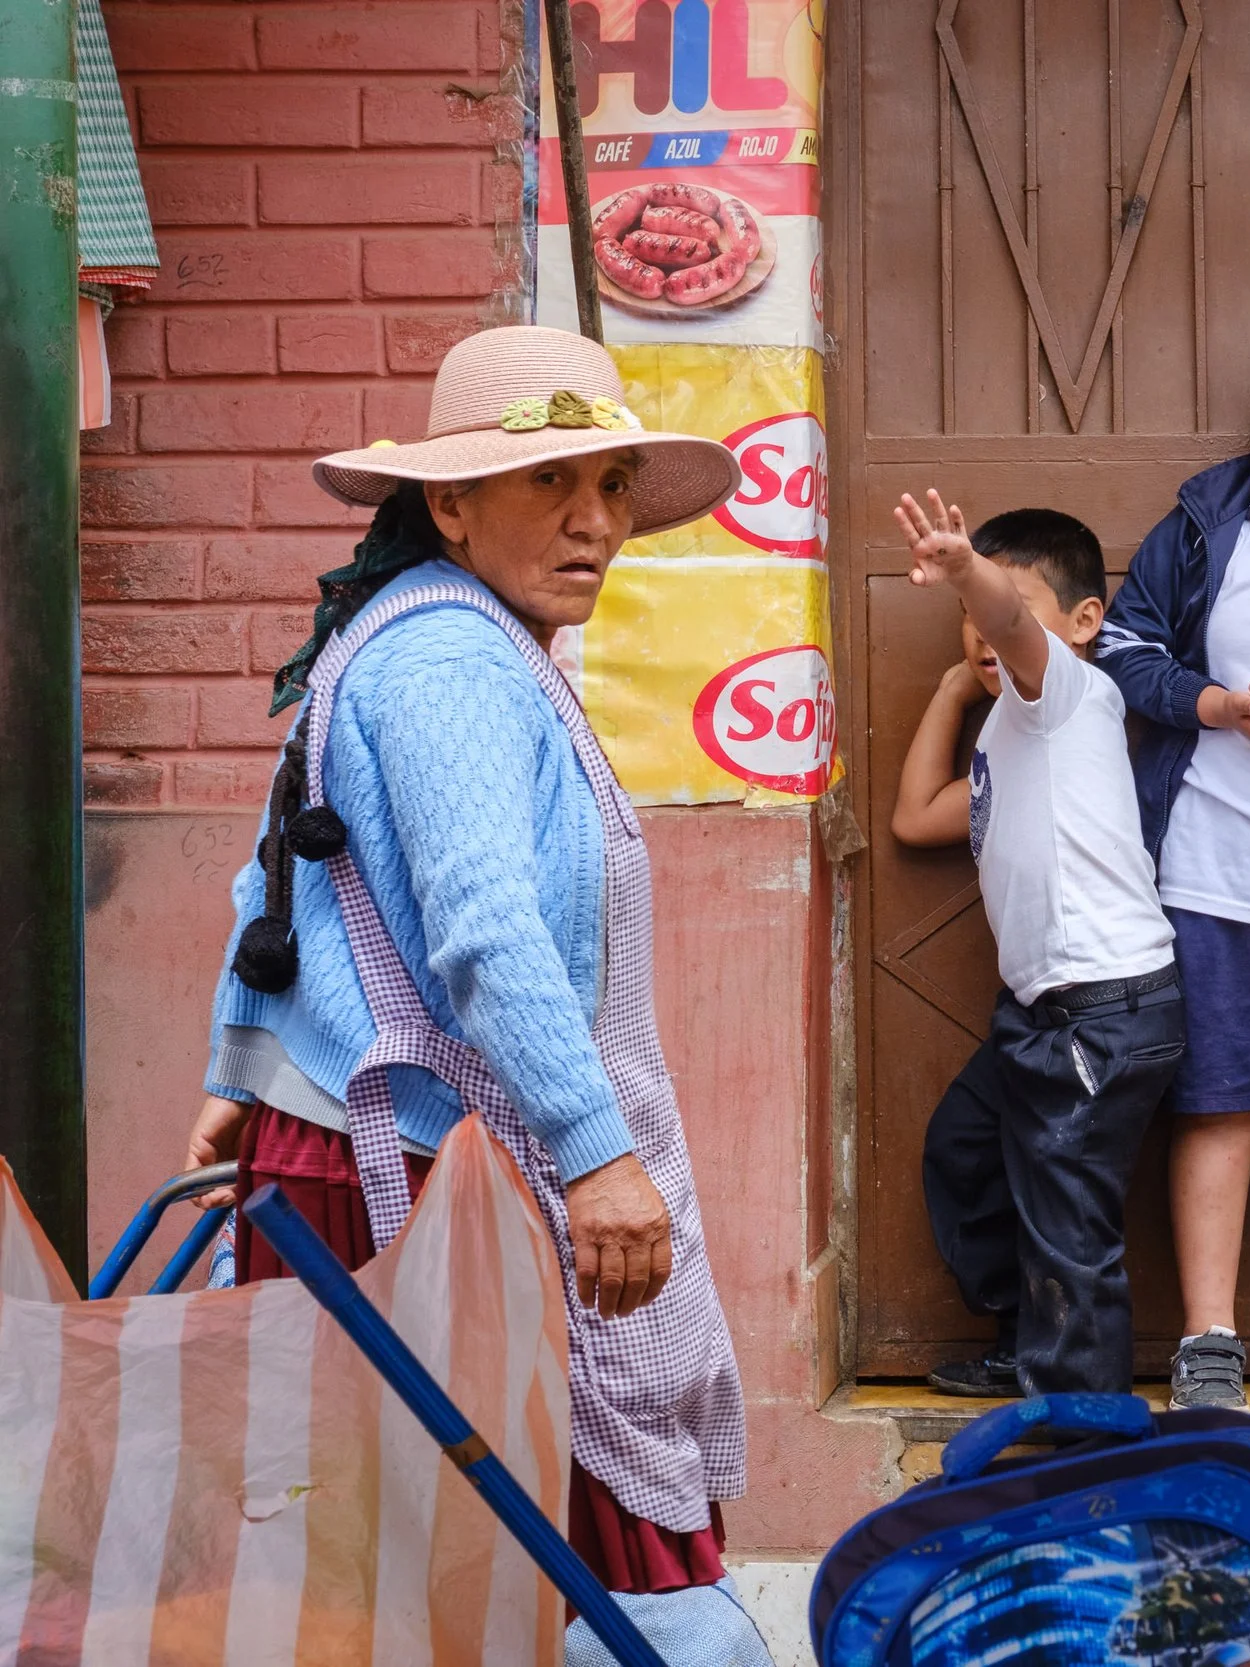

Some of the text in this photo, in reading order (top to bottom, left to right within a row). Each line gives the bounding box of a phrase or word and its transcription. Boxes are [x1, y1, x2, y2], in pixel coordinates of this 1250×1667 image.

[594, 136, 633, 163] CAFÉ
[664, 138, 701, 160] AZUL
[738, 135, 778, 158] ROJO
